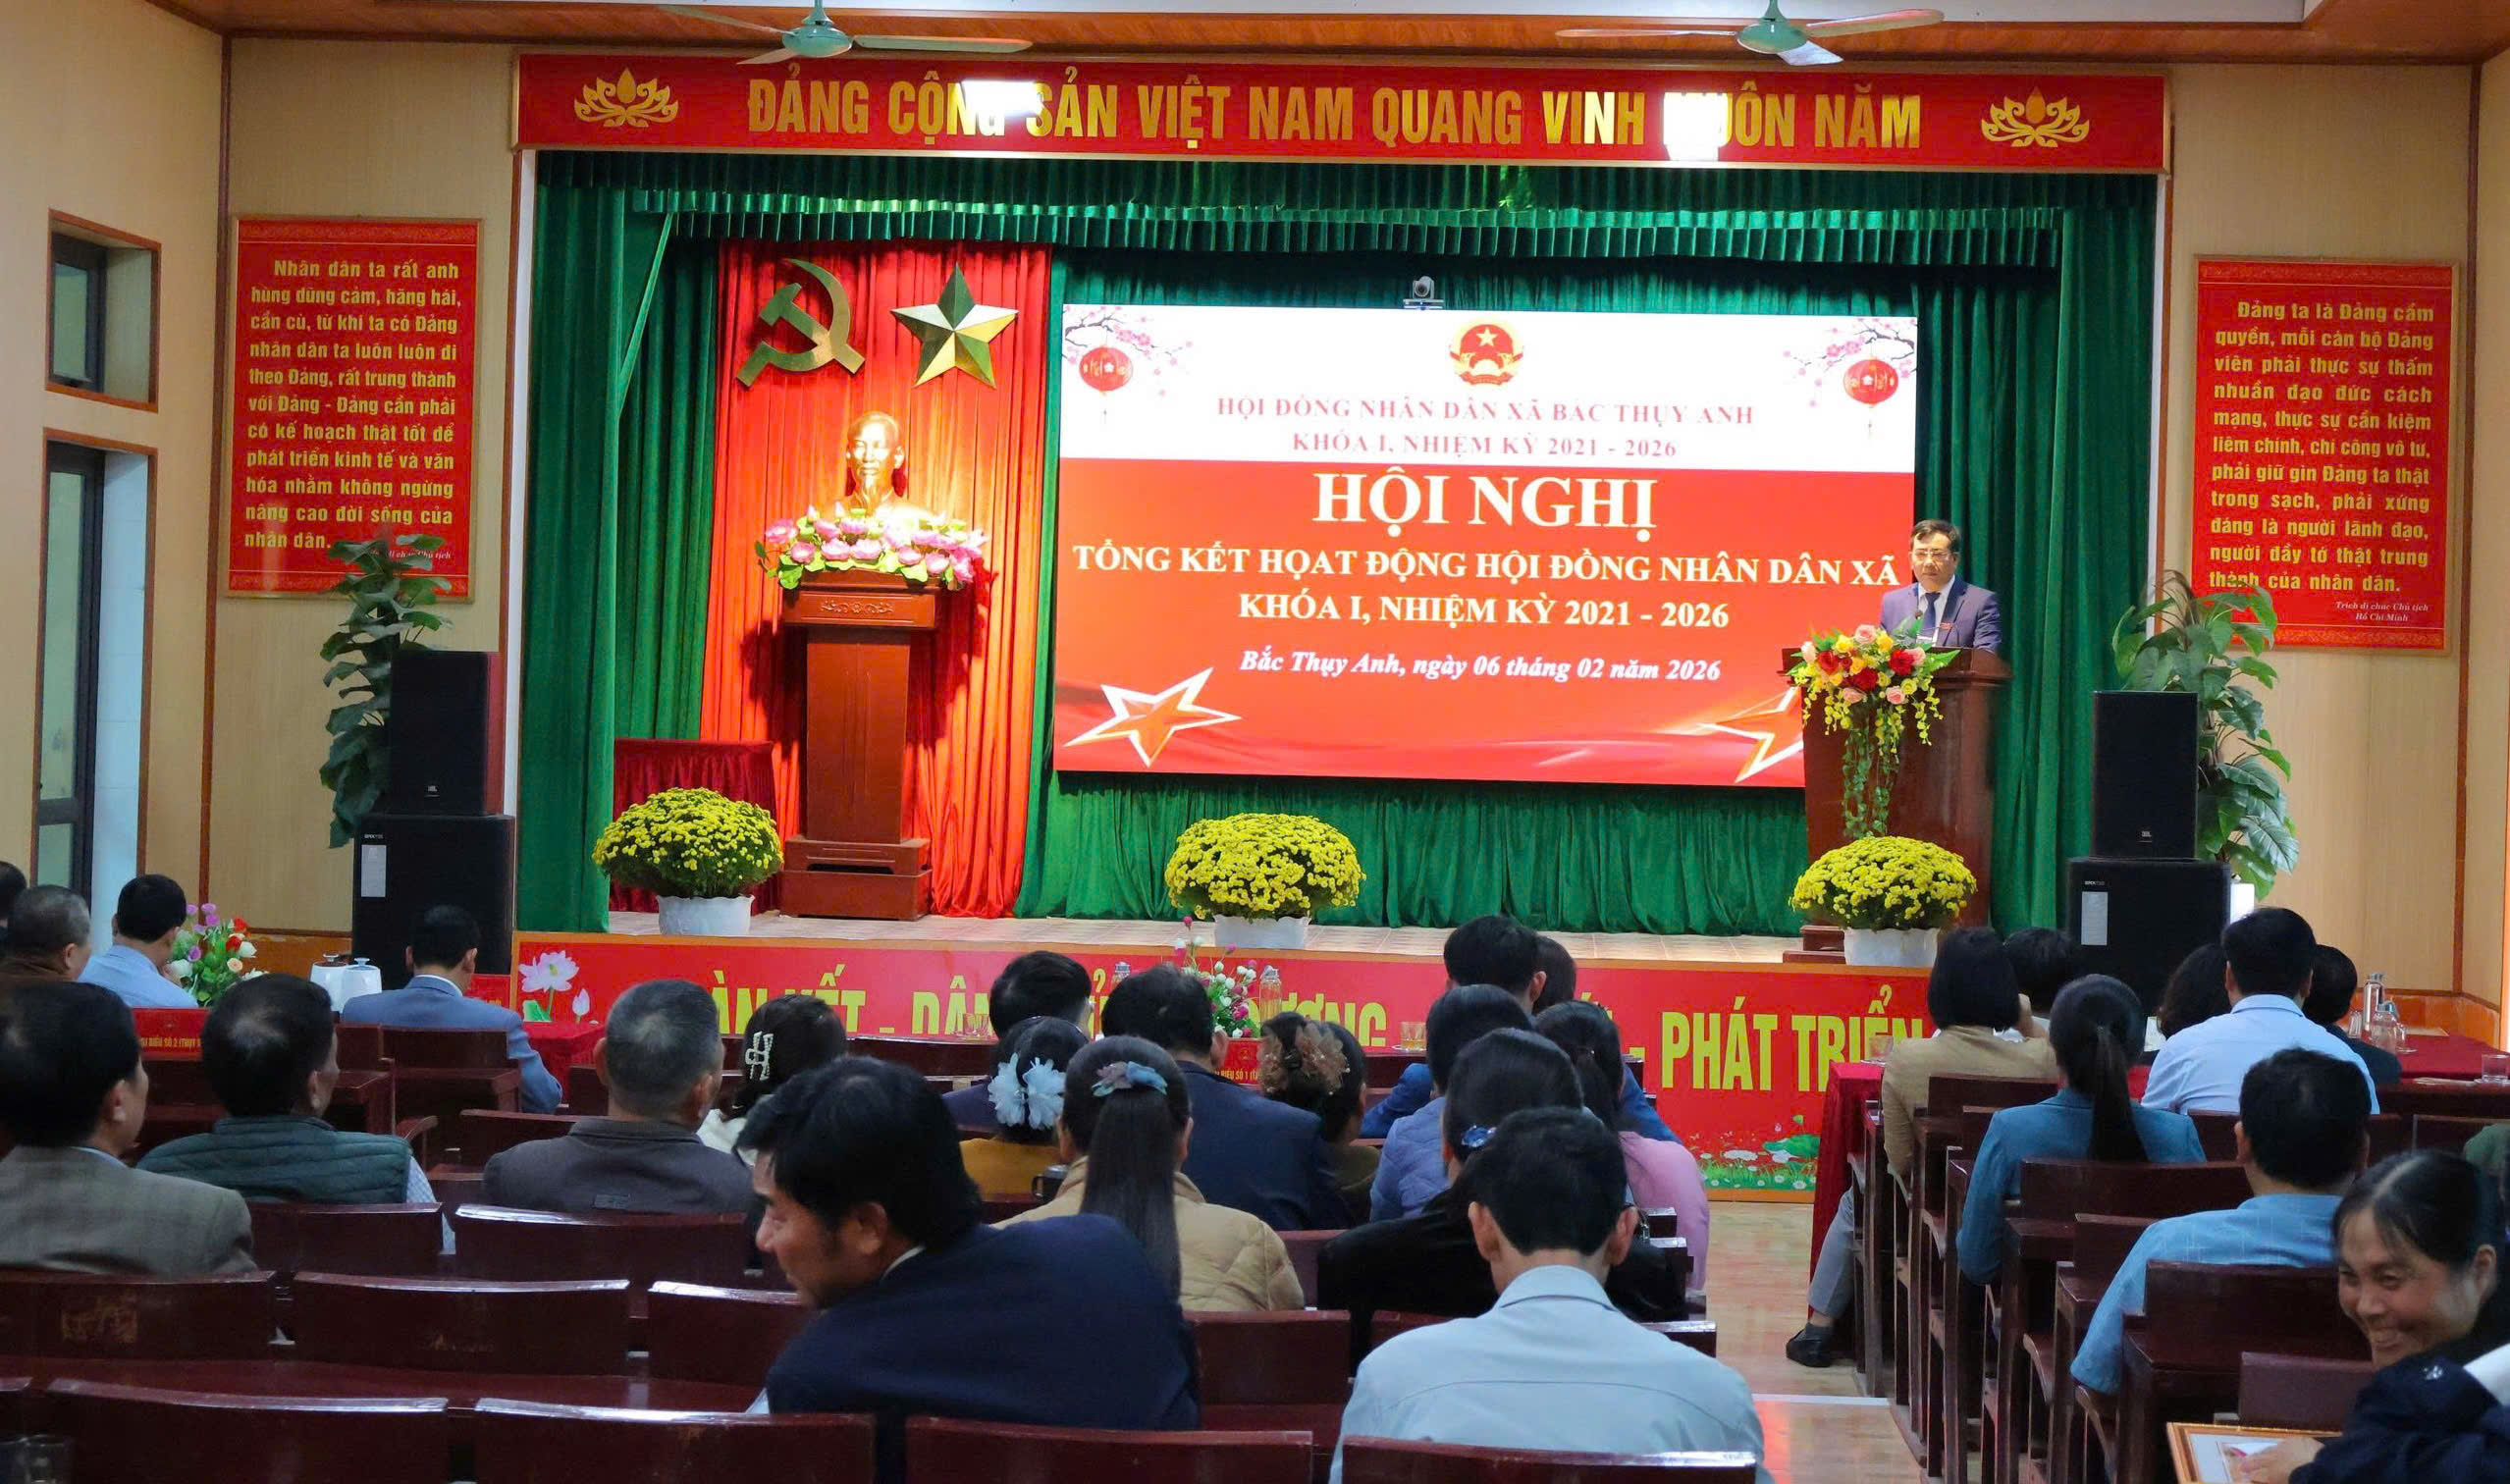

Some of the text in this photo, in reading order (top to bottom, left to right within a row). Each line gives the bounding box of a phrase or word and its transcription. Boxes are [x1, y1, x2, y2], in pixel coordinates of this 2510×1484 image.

[748, 62, 870, 134] ĐẢNG
[1027, 66, 1118, 138] SẢN
[1138, 74, 1231, 149] VIỆT
[1249, 86, 1354, 141] NAM
[1373, 87, 1522, 148] QUANG
[1542, 90, 1646, 145] VINH
[1665, 80, 1796, 147] ÔN
[1814, 83, 1922, 149] NĂM
[274, 260, 320, 277] Nhân
[328, 260, 361, 277] dân
[368, 262, 386, 278] ta
[426, 262, 458, 279] anh
[386, 289, 426, 307] hăng
[2237, 301, 2387, 323] Đảng ta là Đảng
[338, 314, 457, 335] khi ta có Đảng
[249, 342, 436, 360] nhân dân ta luôn luôn
[2360, 331, 2382, 347] bộ
[2387, 332, 2433, 350] Đảng
[2214, 354, 2253, 372] viên
[2262, 356, 2301, 375] phải
[2310, 357, 2349, 378] thực
[2358, 360, 2379, 375] sự
[249, 368, 284, 385] theo
[364, 370, 406, 390] trung
[410, 370, 456, 389] thành
[2286, 384, 2323, 403] đạo
[2383, 387, 2431, 402] cách
[248, 395, 455, 417] với Đảng Đảng phải
[1217, 396, 1265, 420] HỘI
[1361, 396, 1434, 419] NHÂN
[1444, 397, 1498, 420] DÂN
[1508, 398, 1543, 421] XÃ
[1697, 406, 1753, 425] ANH
[2274, 410, 2313, 431] thực
[2320, 414, 2341, 432] sự
[247, 423, 268, 439] có
[303, 423, 356, 444] hoạch
[362, 424, 397, 445] thật
[402, 424, 426, 443] tốt
[1548, 437, 1596, 457] 2021
[1625, 439, 1677, 458] 2026
[2213, 436, 2250, 453] liêm
[2340, 439, 2380, 458] công
[2386, 440, 2405, 456] vô
[334, 450, 372, 468] kinh
[399, 454, 419, 469] và
[423, 452, 454, 470] văn
[2212, 461, 2251, 482] phải
[2322, 463, 2368, 485] Đảng
[2373, 467, 2389, 483] ta
[2395, 467, 2430, 485] thật
[245, 476, 278, 494] hóa
[340, 478, 394, 498] không
[1311, 465, 1659, 543] HỘI NGHỊ
[2211, 490, 2260, 509] trong
[2332, 492, 2373, 511] phải
[245, 504, 453, 525] nâng cao của
[2210, 516, 2254, 537] đáng
[2262, 517, 2278, 535] là
[2286, 519, 2336, 538] người
[244, 529, 332, 550] nhân dân.
[1072, 538, 1171, 571] TỔNG
[1180, 540, 1251, 573] KẾT
[1365, 548, 1467, 583] ĐỘNG
[1475, 550, 1540, 585] HỘI
[1549, 548, 1650, 581] ĐỒNG
[1660, 550, 1759, 583] NHÂN
[1769, 552, 1842, 584] DÂN
[1851, 555, 1902, 587] XÃ
[2210, 544, 2261, 563] người
[2336, 547, 2372, 567] thật
[2379, 549, 2429, 568] trung
[2268, 570, 2302, 590] của
[2309, 573, 2354, 592] nhân
[2362, 574, 2402, 593] dân.
[1239, 587, 1341, 619] KHÓA
[1350, 596, 1371, 625] I,
[1379, 594, 1496, 629] NHIỆM
[1506, 592, 1557, 624] KỲ
[1565, 600, 1629, 626] 2021
[1661, 602, 1729, 628] 2026
[1238, 646, 1721, 683] Bắc Thụy Anh, ngày 06 tháng 02 năm 2026
[1661, 996, 1778, 1090] PHÁT
